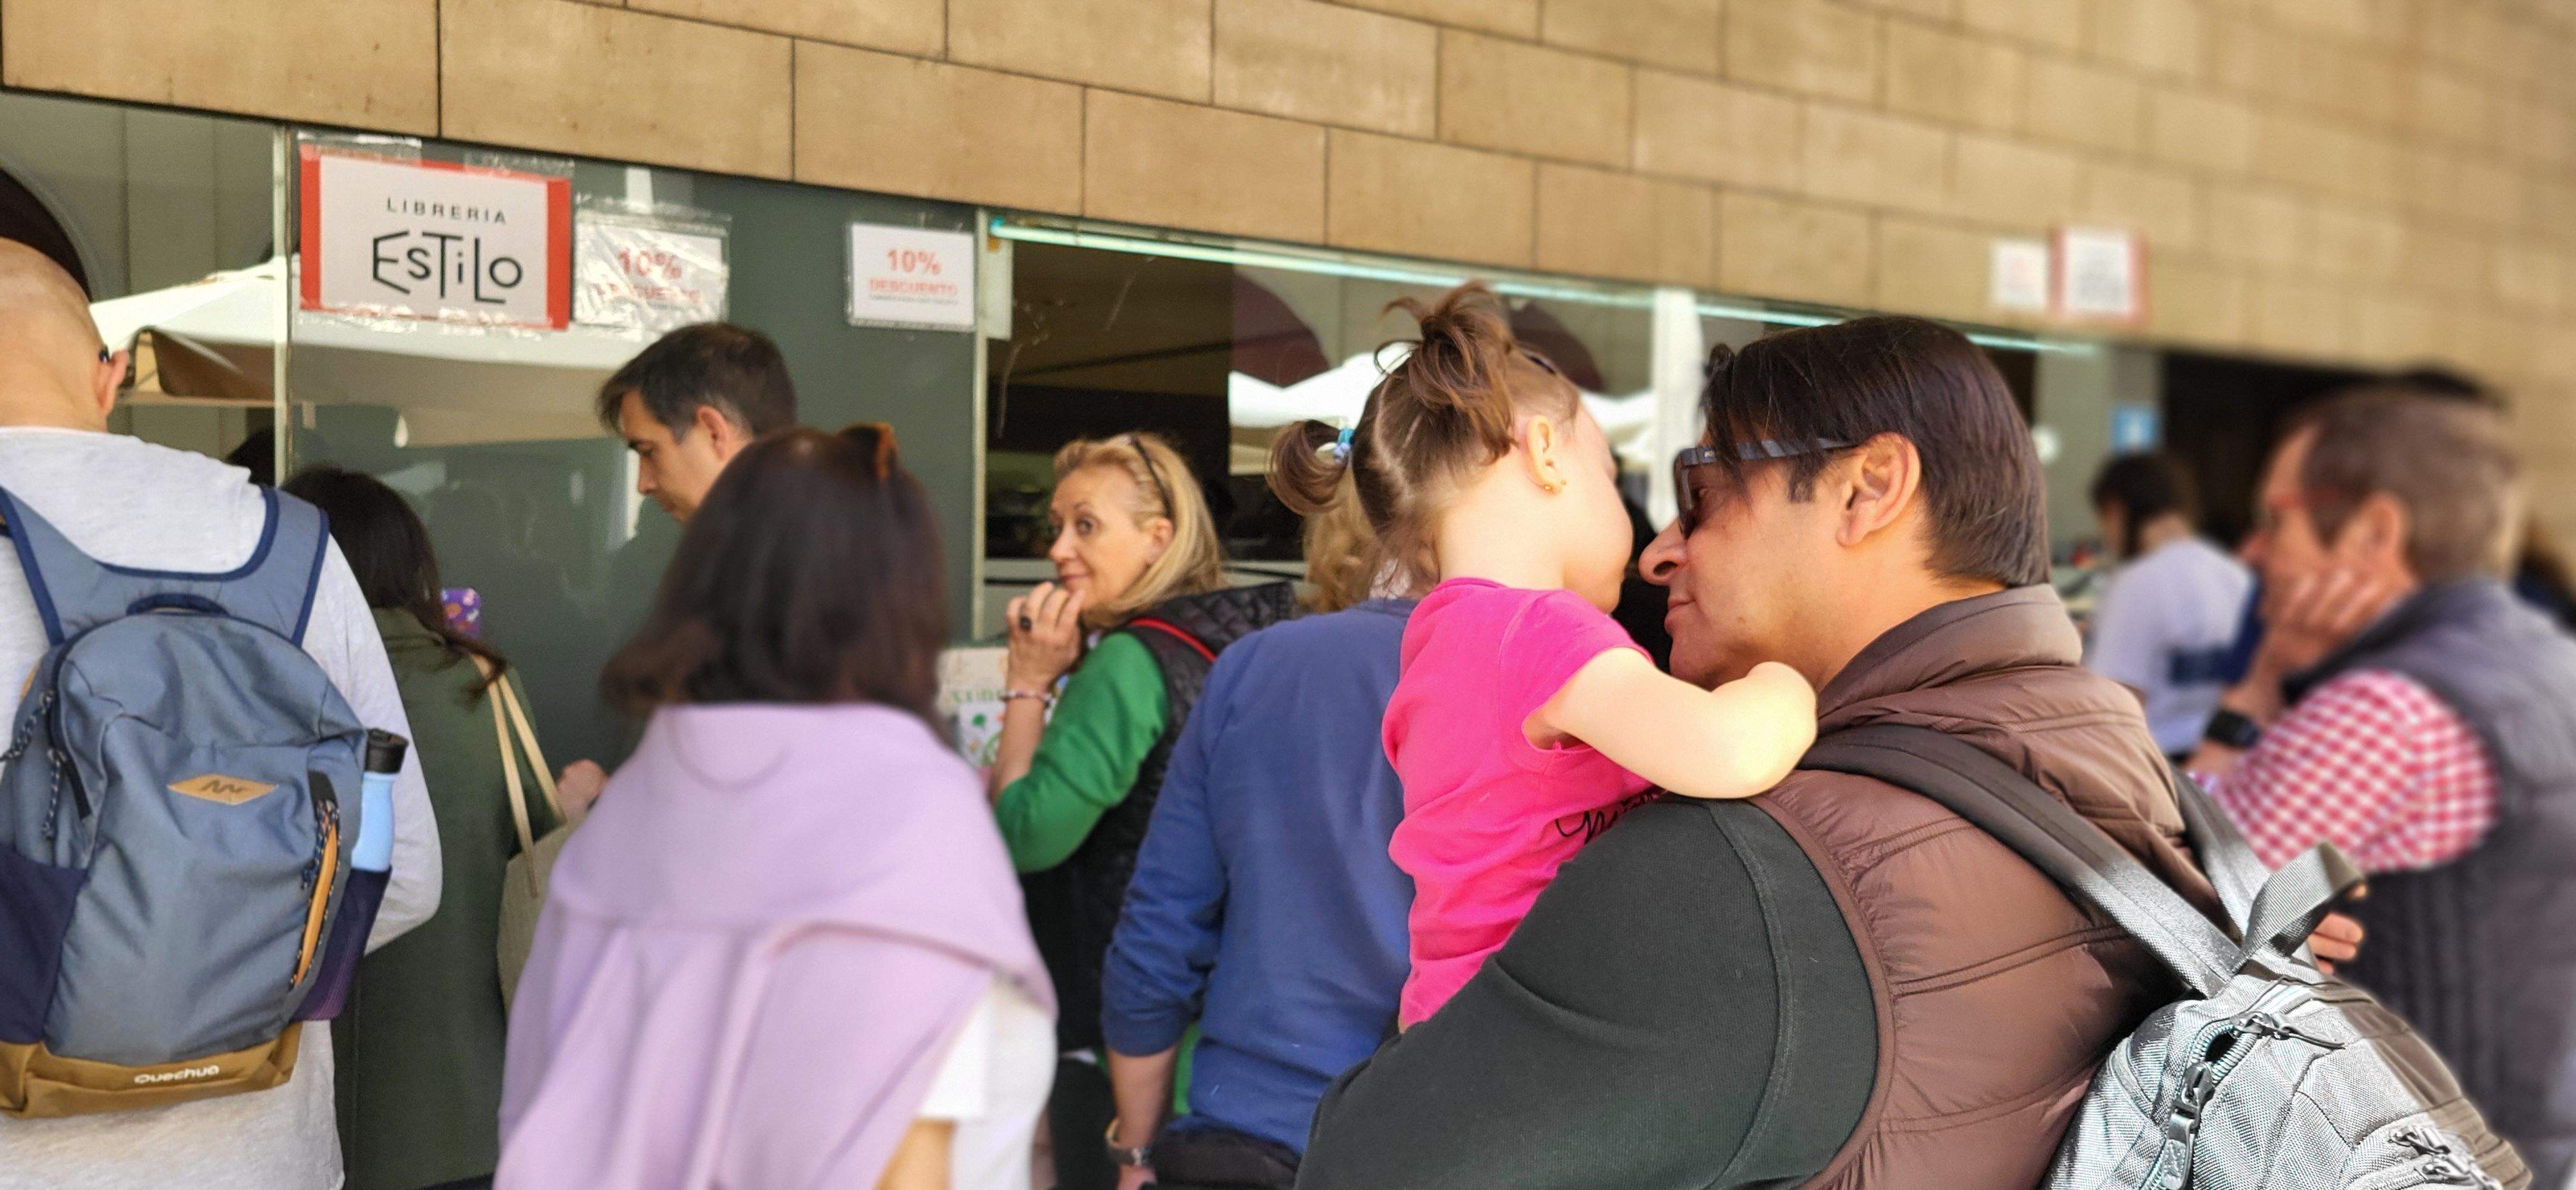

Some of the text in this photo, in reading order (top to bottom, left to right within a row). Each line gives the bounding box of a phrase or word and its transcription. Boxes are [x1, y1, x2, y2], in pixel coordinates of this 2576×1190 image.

[387, 196, 506, 223] LIBRERIA
[618, 248, 683, 279] 10%
[886, 248, 942, 276] 10%
[134, 1064, 220, 1084] Quechua
